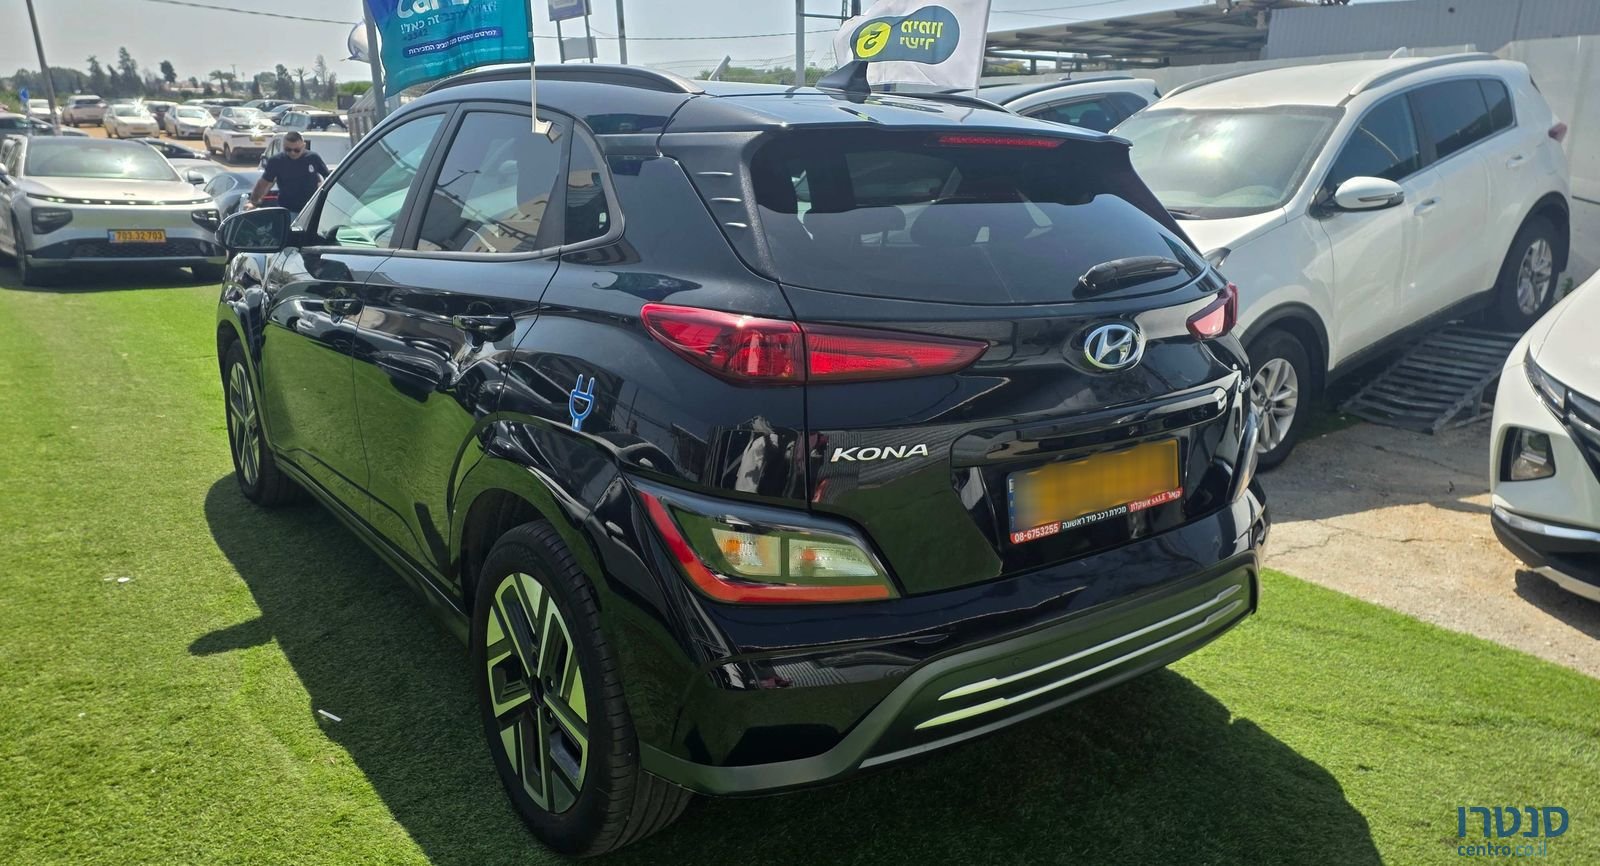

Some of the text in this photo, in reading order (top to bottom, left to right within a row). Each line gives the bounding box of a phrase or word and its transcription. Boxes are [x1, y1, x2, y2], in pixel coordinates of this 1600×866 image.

[427, 14, 440, 26] זה
[408, 44, 435, 55] המכירות
[830, 443, 929, 462] KONA
[1062, 505, 1127, 530] מכירת רכב מיד ראשונה
[1014, 523, 1058, 543] 08-6753255
